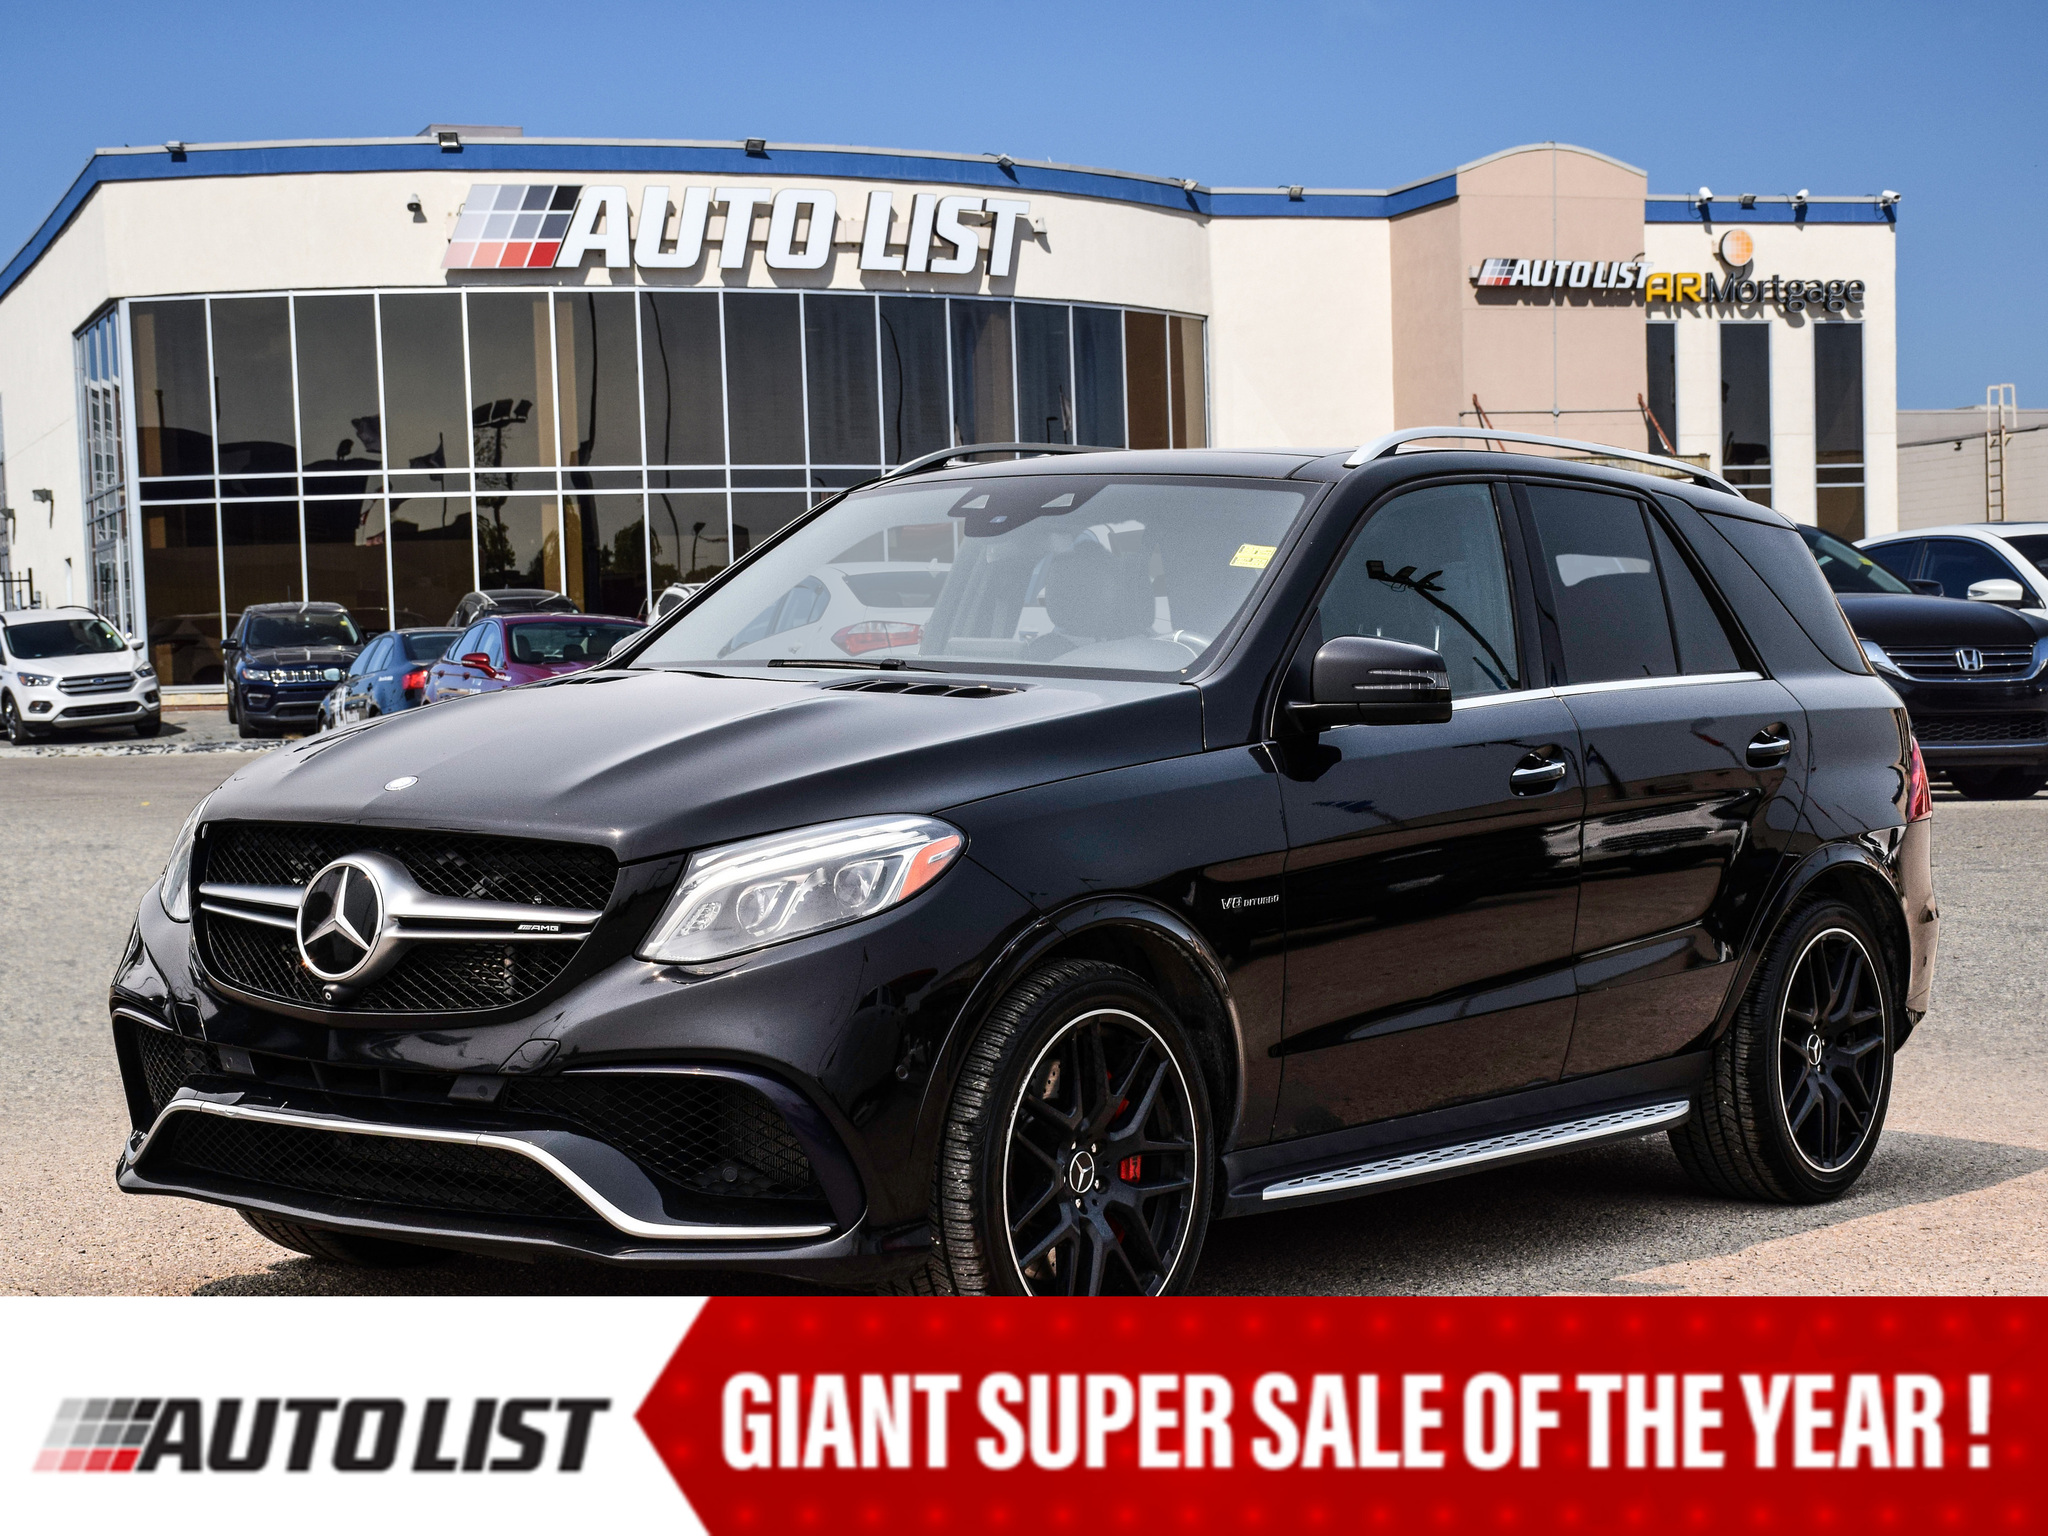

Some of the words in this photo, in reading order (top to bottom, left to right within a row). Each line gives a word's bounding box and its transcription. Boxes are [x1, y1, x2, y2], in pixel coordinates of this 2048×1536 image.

[556, 185, 837, 271] AUTO
[859, 190, 1031, 277] LIST
[1645, 272, 1701, 303] AR
[1705, 272, 1865, 313] Mortgage
[530, 924, 559, 932] AMG
